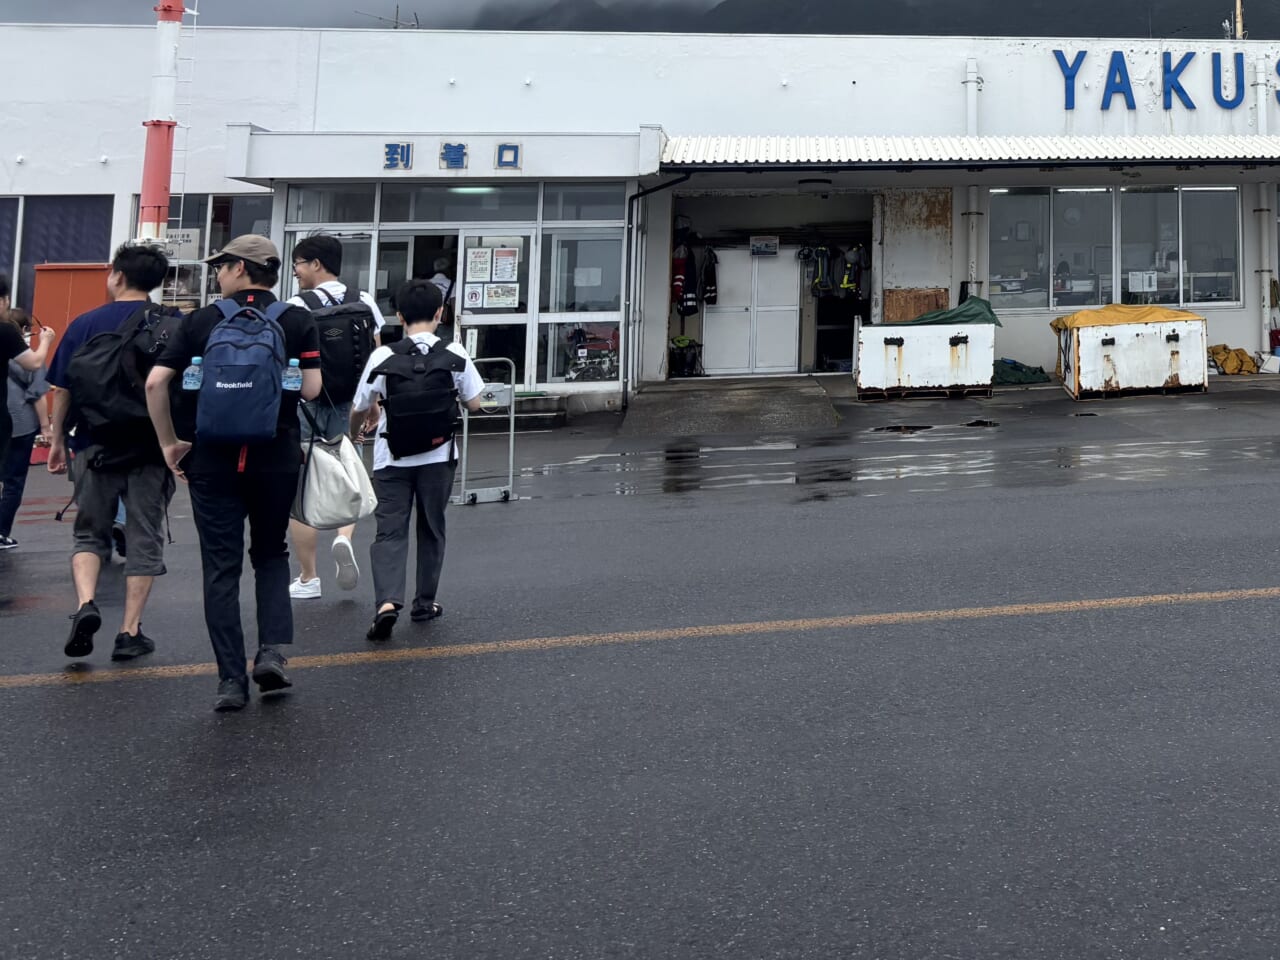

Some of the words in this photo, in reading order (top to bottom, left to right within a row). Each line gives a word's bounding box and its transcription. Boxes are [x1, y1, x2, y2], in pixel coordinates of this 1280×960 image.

[385, 143, 519, 169] 到着口
[215, 381, 253, 389] Brookfield
